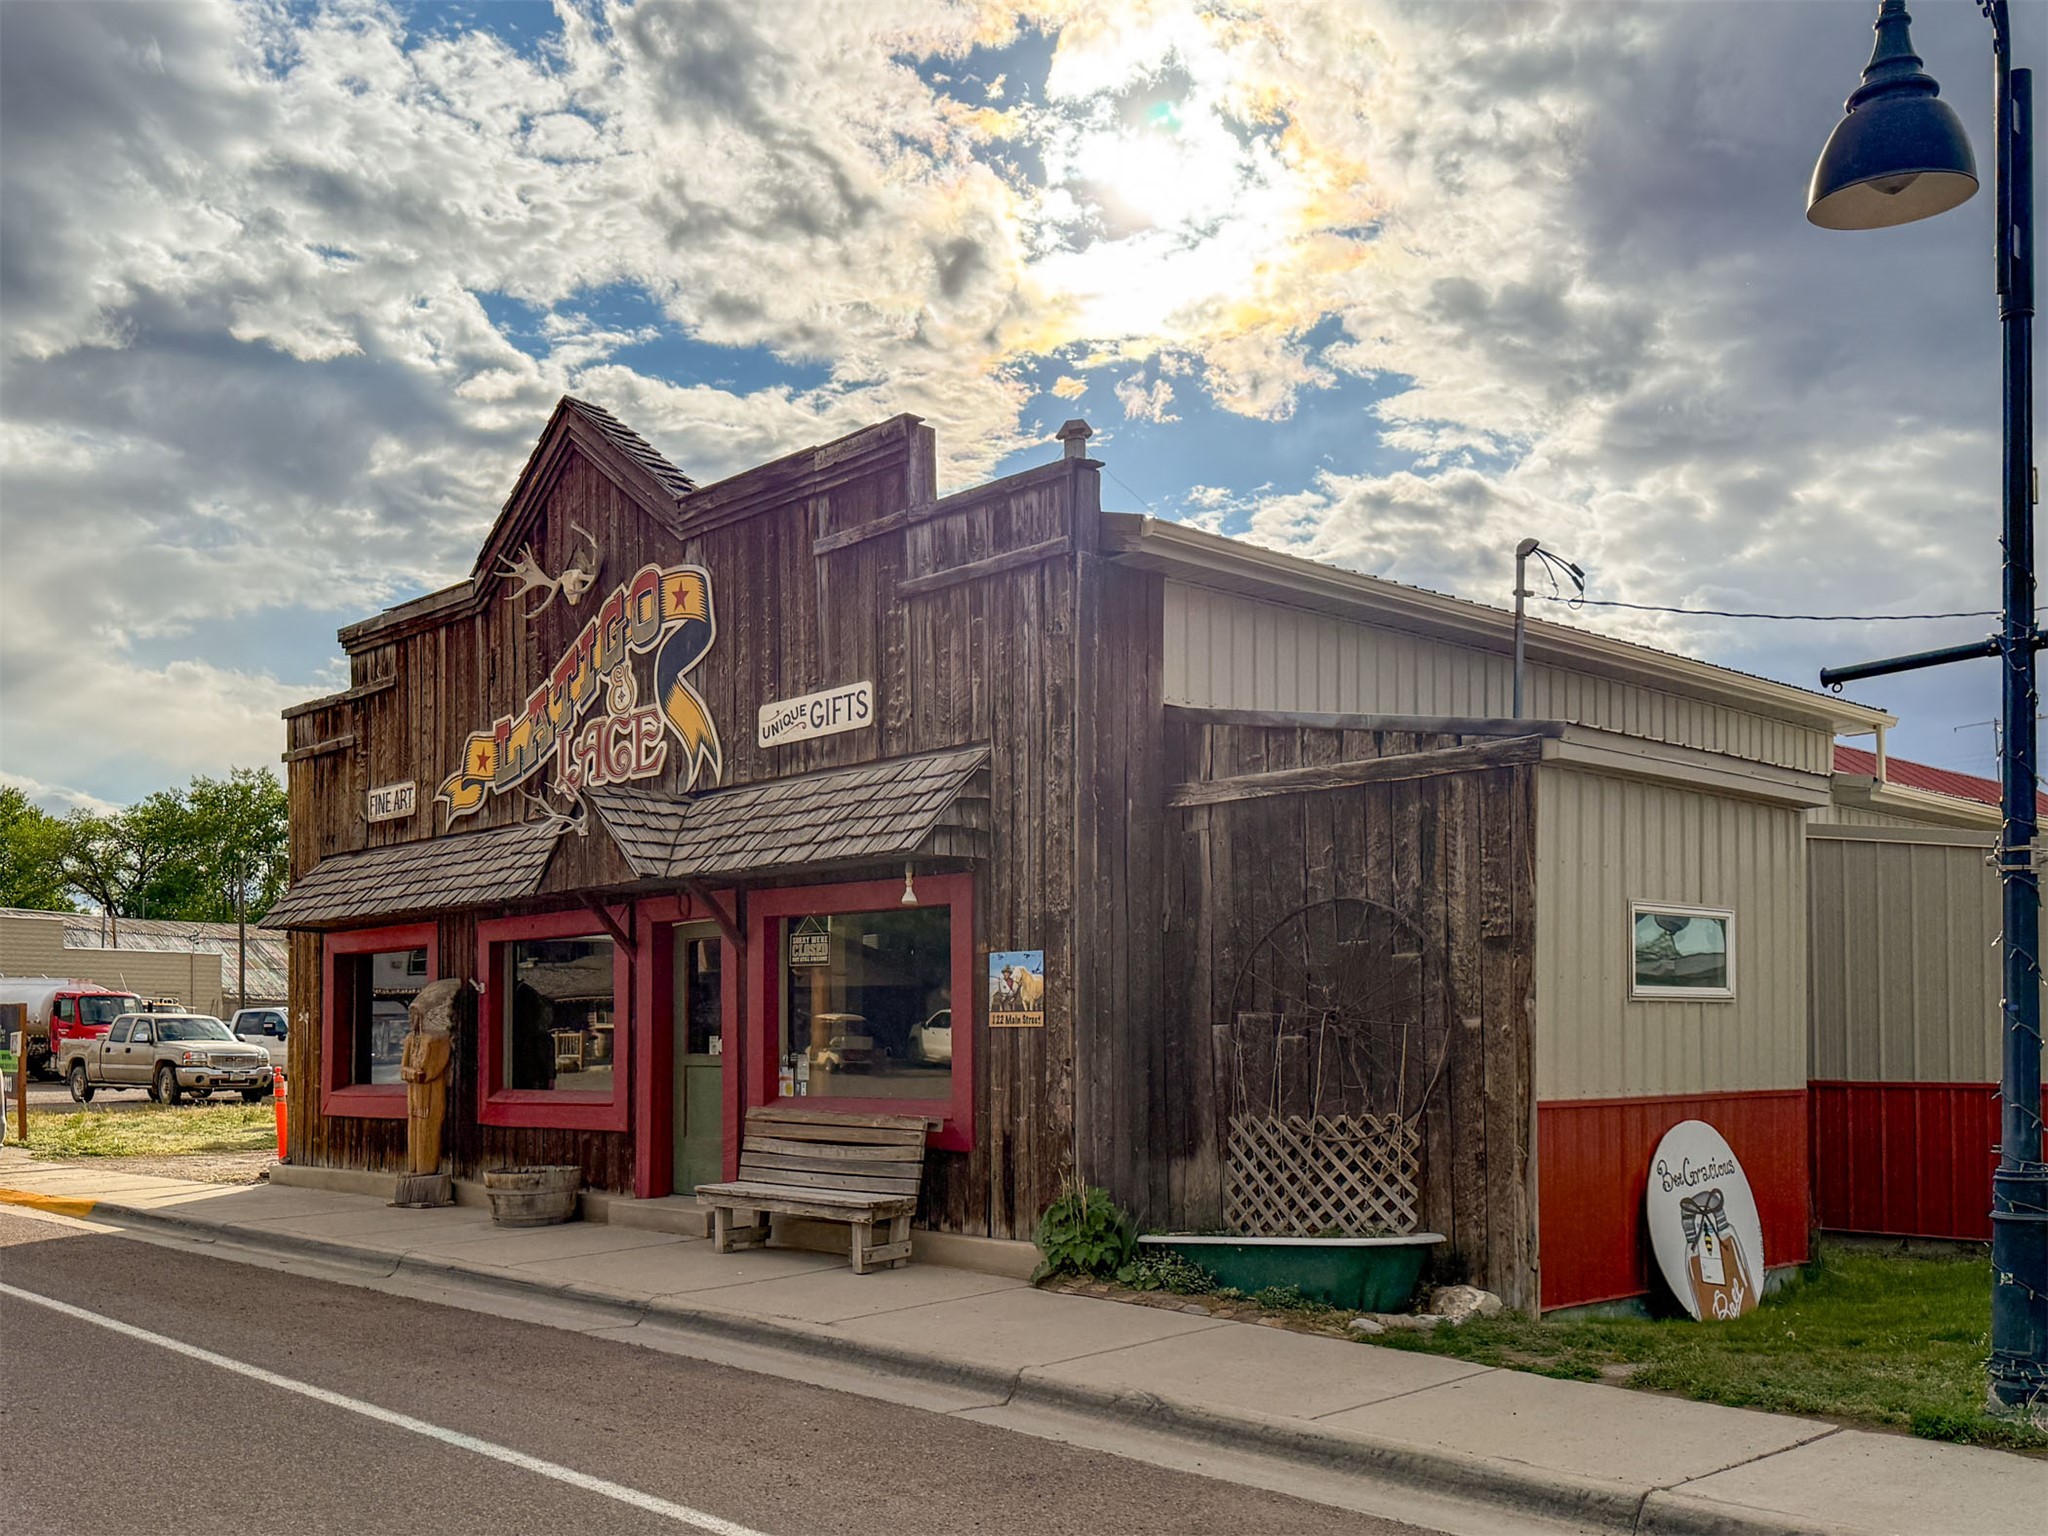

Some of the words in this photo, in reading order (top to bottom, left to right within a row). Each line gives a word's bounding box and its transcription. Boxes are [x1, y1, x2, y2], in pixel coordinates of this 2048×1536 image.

[494, 568, 662, 787] LATIGO
[610, 664, 634, 715] &
[762, 704, 807, 740] UNIQUE
[810, 689, 869, 729] GIFTS
[557, 707, 665, 788] LACE
[369, 791, 392, 817] FINE
[393, 787, 414, 812] ART
[792, 943, 828, 957] CLOSED
[992, 1014, 1004, 1025] 122
[1005, 1014, 1021, 1025] Main
[1022, 1014, 1041, 1025] Street
